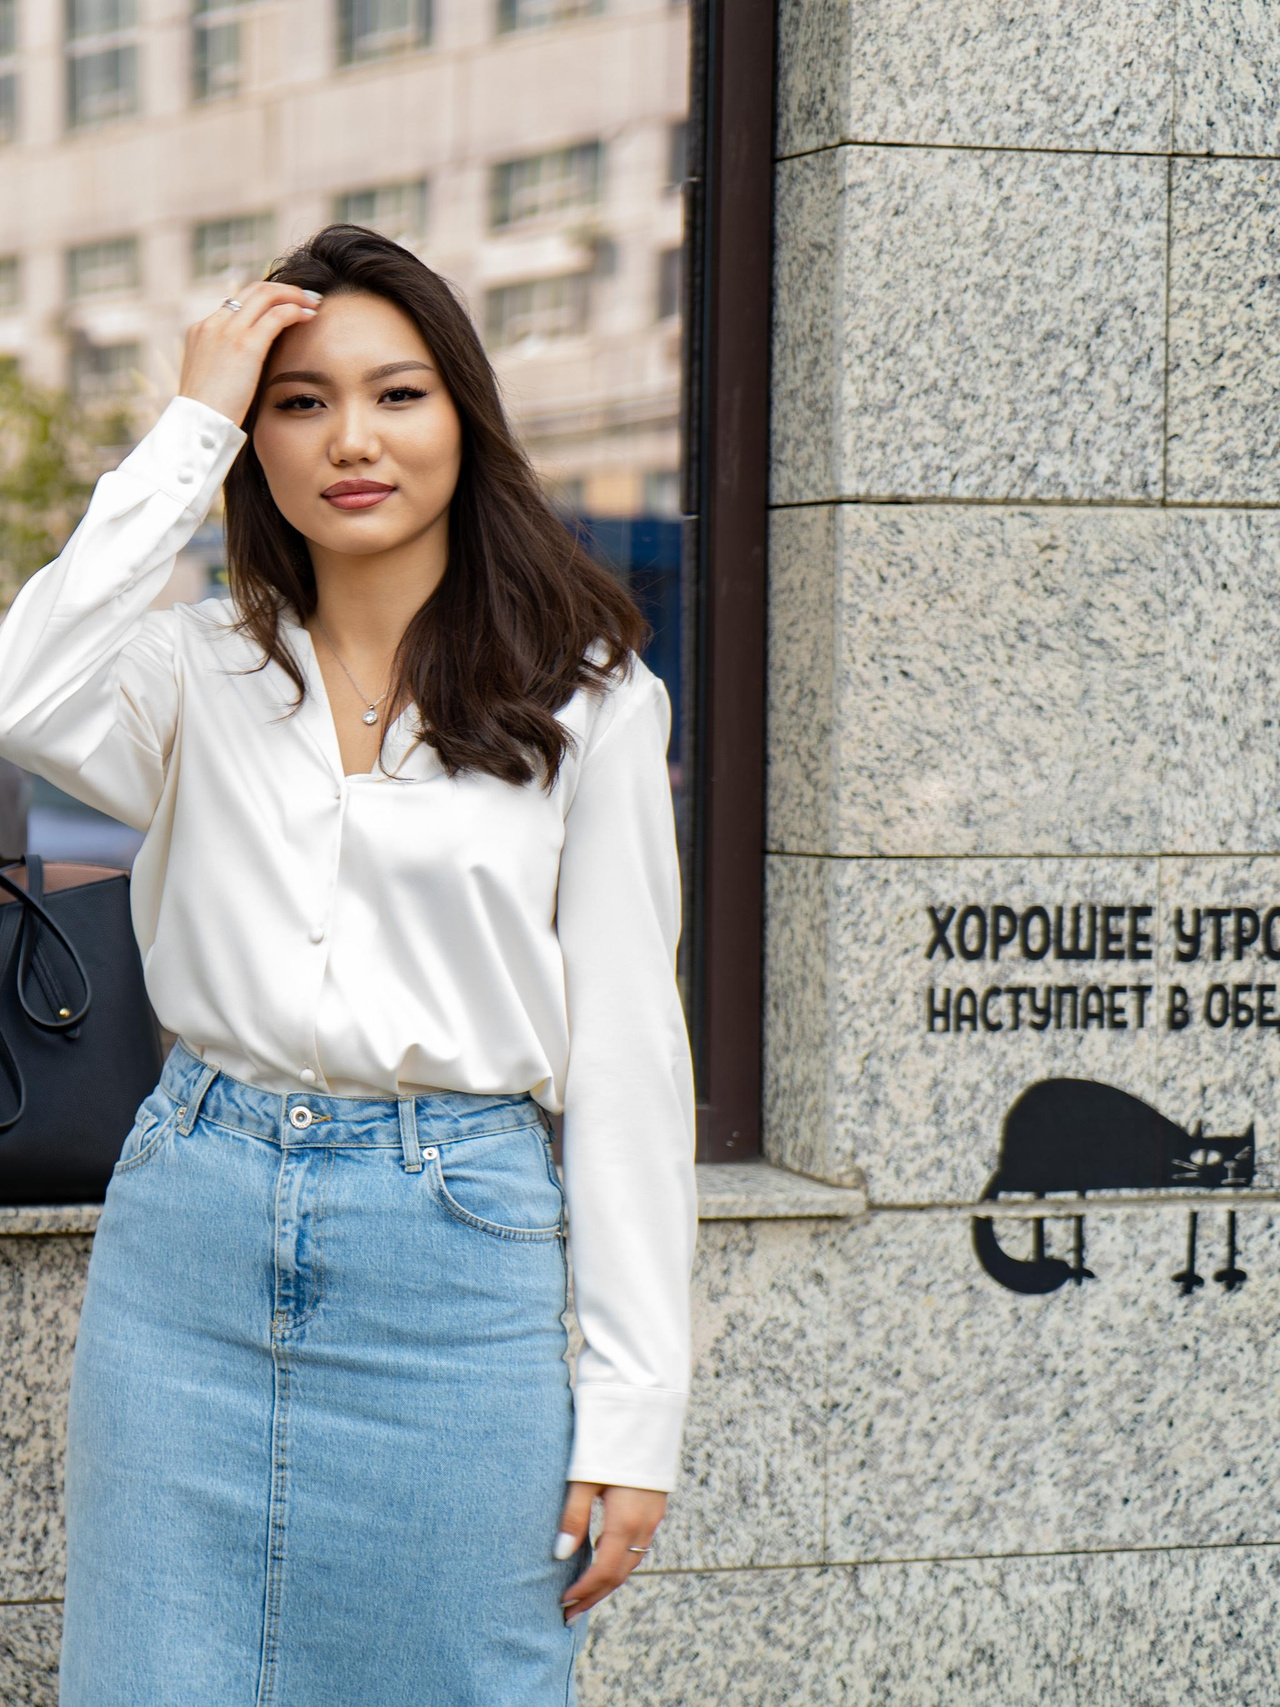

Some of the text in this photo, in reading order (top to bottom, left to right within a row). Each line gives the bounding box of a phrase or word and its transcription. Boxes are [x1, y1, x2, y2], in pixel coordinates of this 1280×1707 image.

[924, 905, 1153, 961] ХОРОШЕЕ
[927, 983, 1280, 1032] НАСТУПАЕТ В ОБЕ
